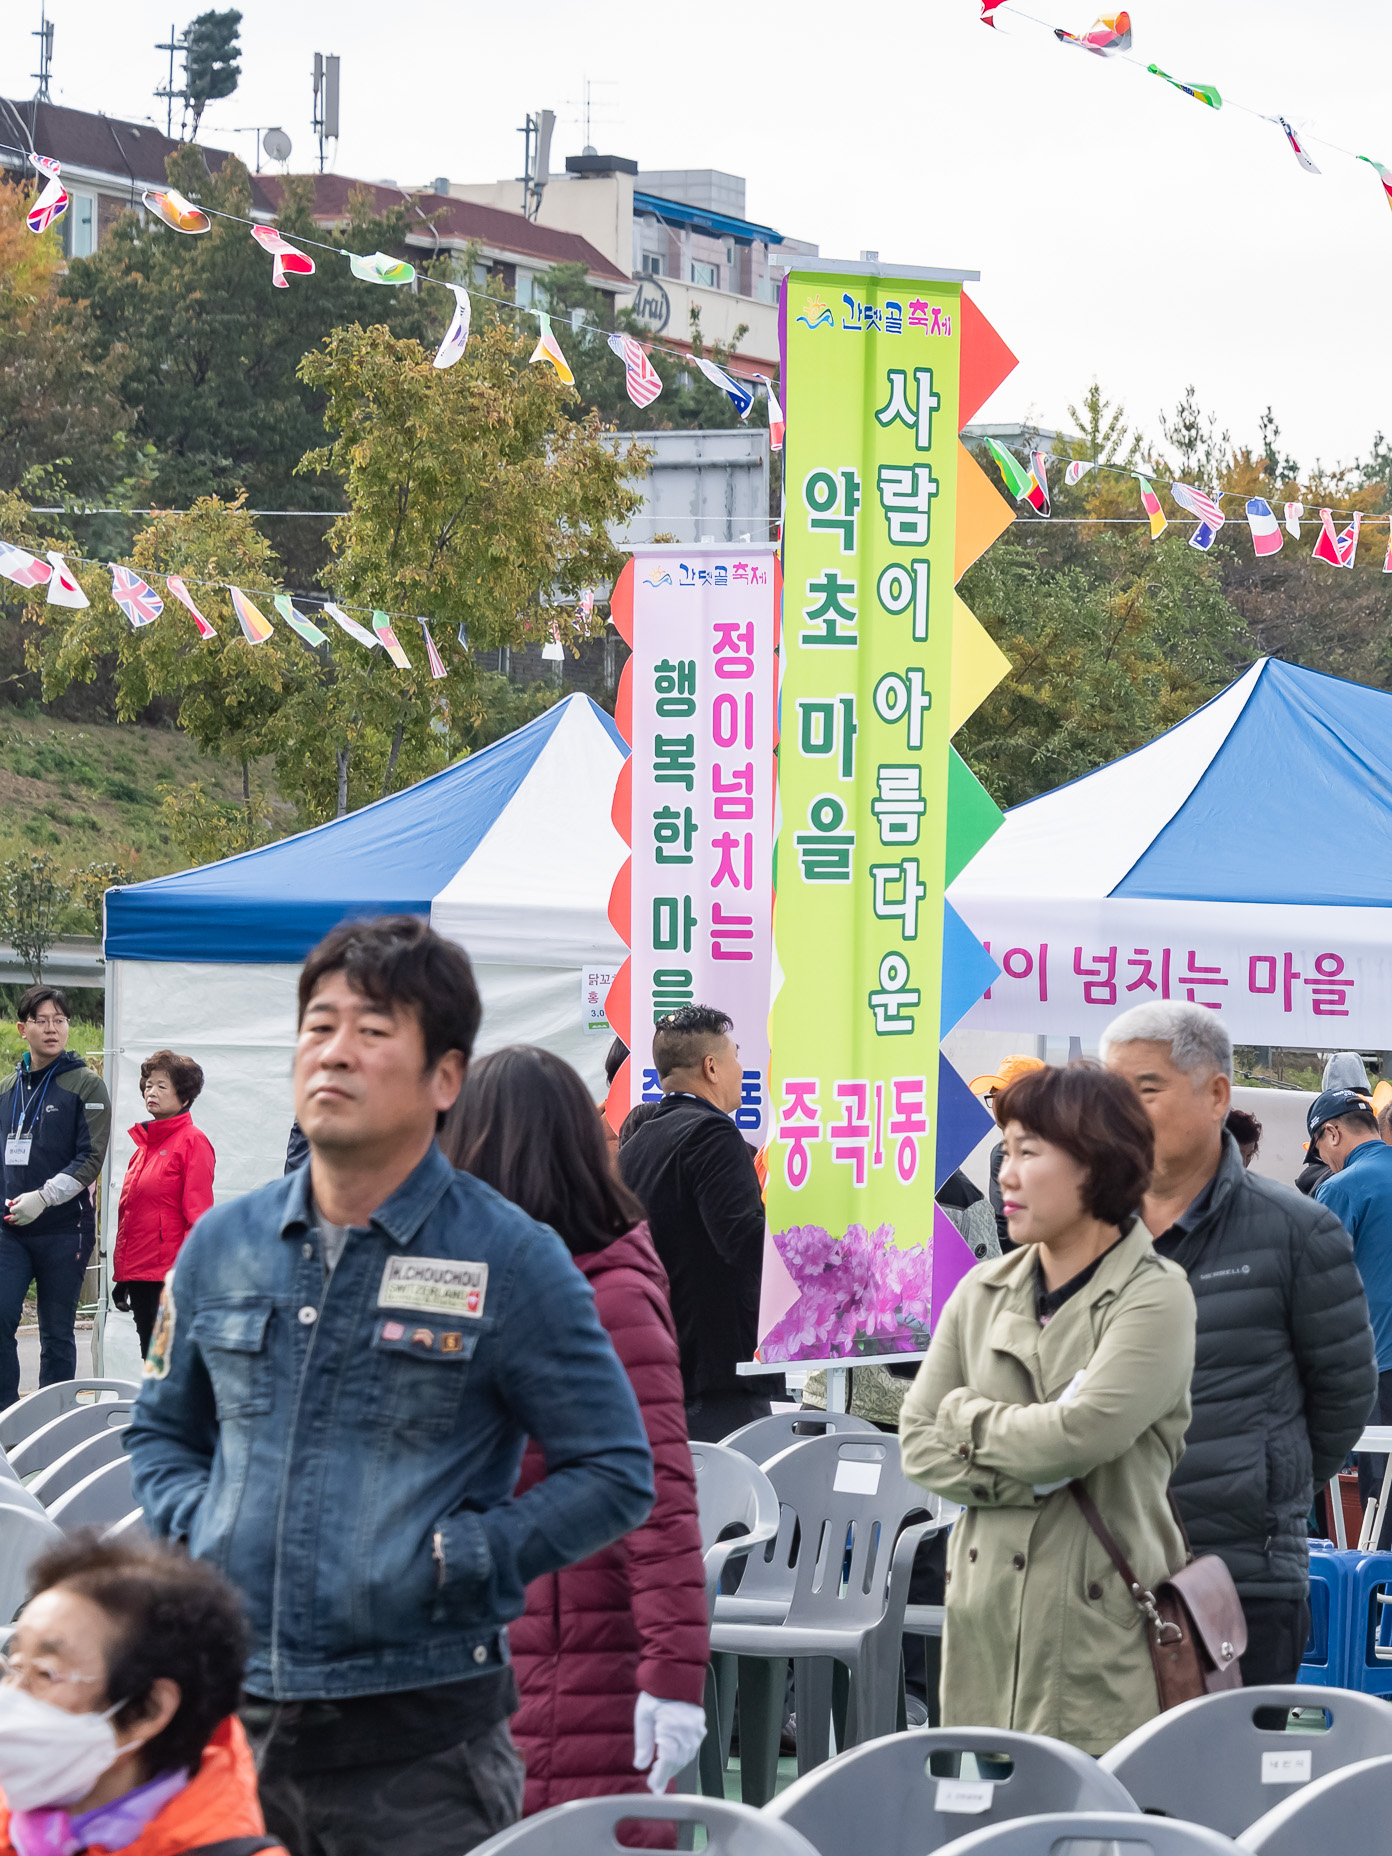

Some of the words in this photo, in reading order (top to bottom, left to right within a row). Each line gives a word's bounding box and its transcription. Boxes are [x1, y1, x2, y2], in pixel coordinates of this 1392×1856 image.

[907, 298, 952, 336] 축제
[732, 562, 767, 585] 축제
[802, 469, 861, 649] 약초
[877, 368, 939, 642] 사람이
[653, 659, 698, 864] 행복한
[793, 695, 859, 883] 마을
[870, 668, 931, 1035] 아름다운
[588, 973, 617, 986] 닭꼬
[983, 942, 1048, 1002] 이
[1073, 945, 1229, 1010] 넘치는
[1247, 951, 1355, 1016] 마을
